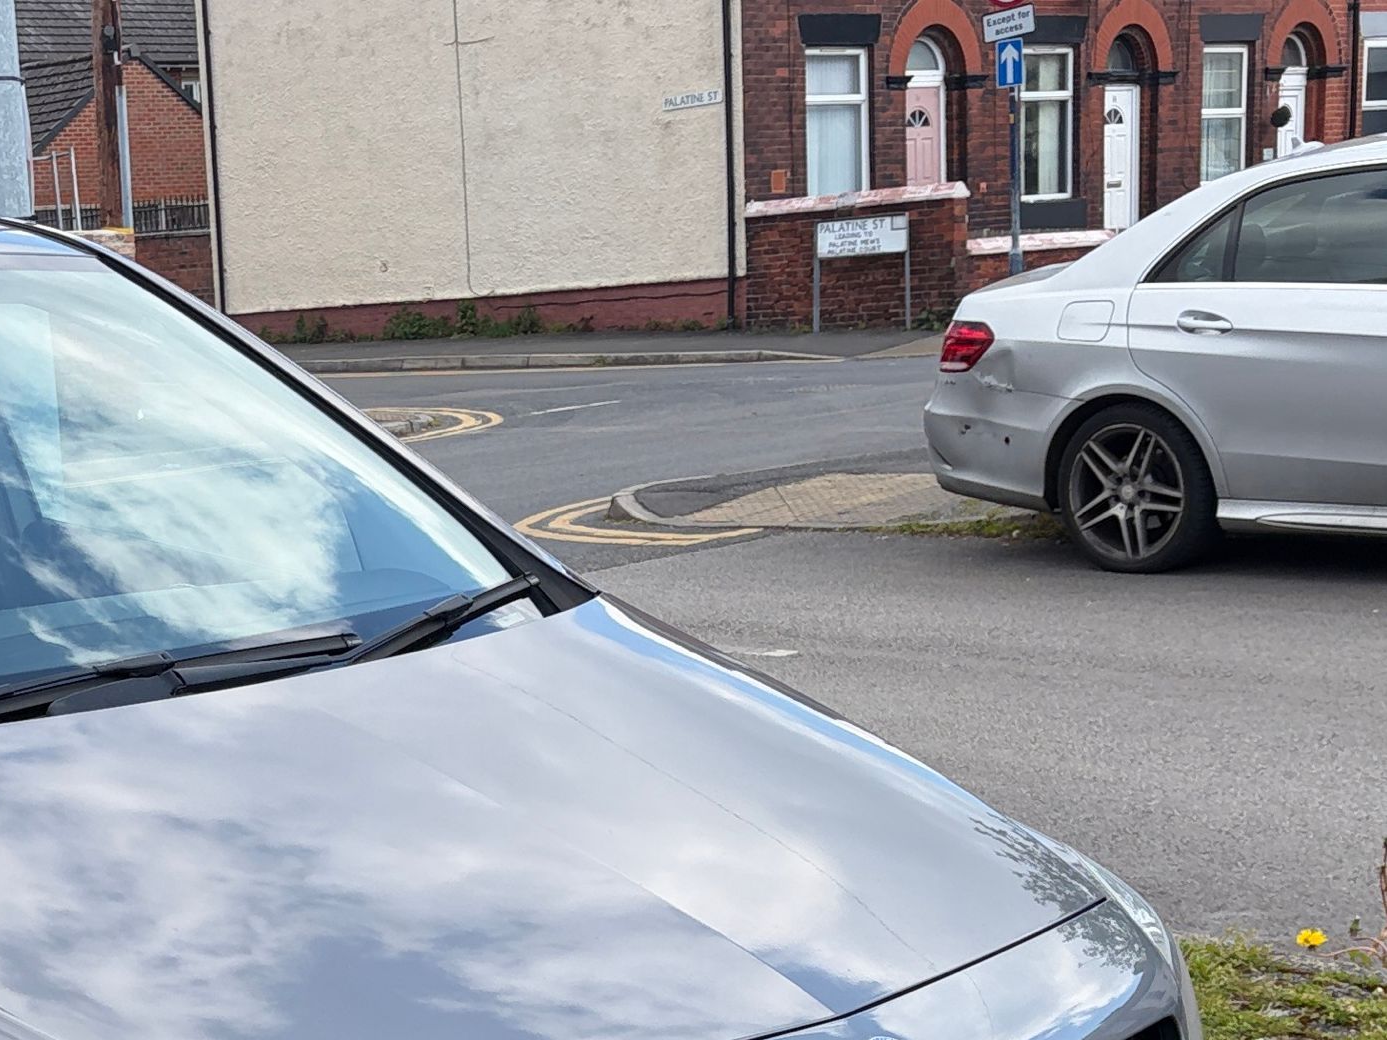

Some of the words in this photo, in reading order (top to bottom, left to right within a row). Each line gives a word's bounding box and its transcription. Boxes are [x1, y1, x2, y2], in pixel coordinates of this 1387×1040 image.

[986, 13, 1016, 27] Except
[1017, 11, 1030, 20] for
[995, 23, 1024, 36] access
[664, 93, 705, 108] PALATINE
[707, 90, 718, 101] ST
[819, 220, 869, 234] PALATINE
[872, 219, 886, 230] ST
[835, 232, 862, 240] LEADING
[864, 230, 873, 238] TO
